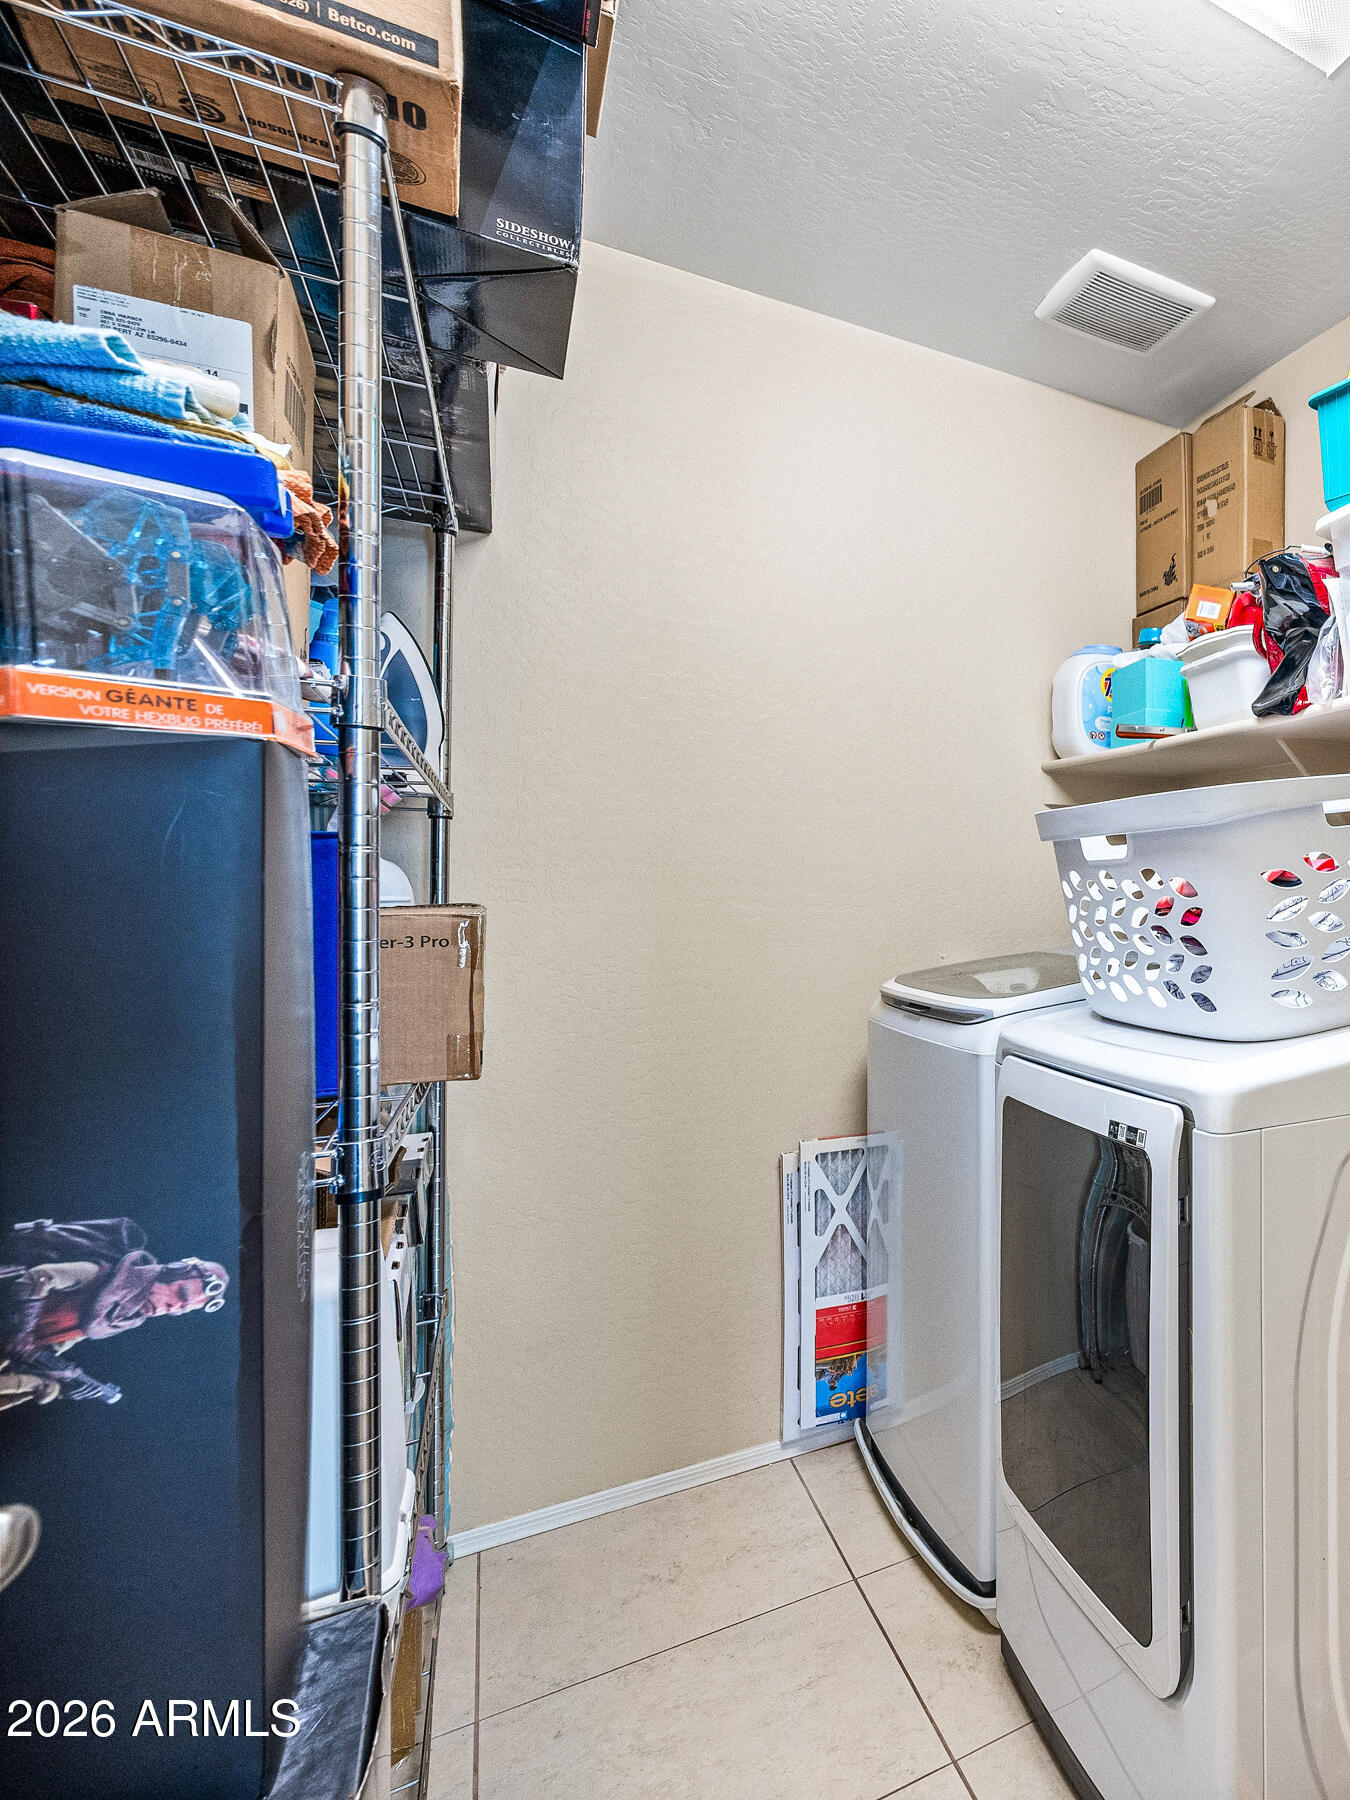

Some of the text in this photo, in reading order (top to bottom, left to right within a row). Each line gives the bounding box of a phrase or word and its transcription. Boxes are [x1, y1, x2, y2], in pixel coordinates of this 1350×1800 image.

[327, 7, 417, 52] Betco.com
[496, 218, 572, 249] SIDESHOW
[496, 230, 570, 257] COLLECTIBLES
[26, 682, 224, 715] VERSION GÉANTE DE
[78, 703, 130, 720] VOTRE
[135, 710, 201, 727] HEXBUG
[380, 935, 449, 948] er-3 Pro
[829, 1386, 868, 1408] ete
